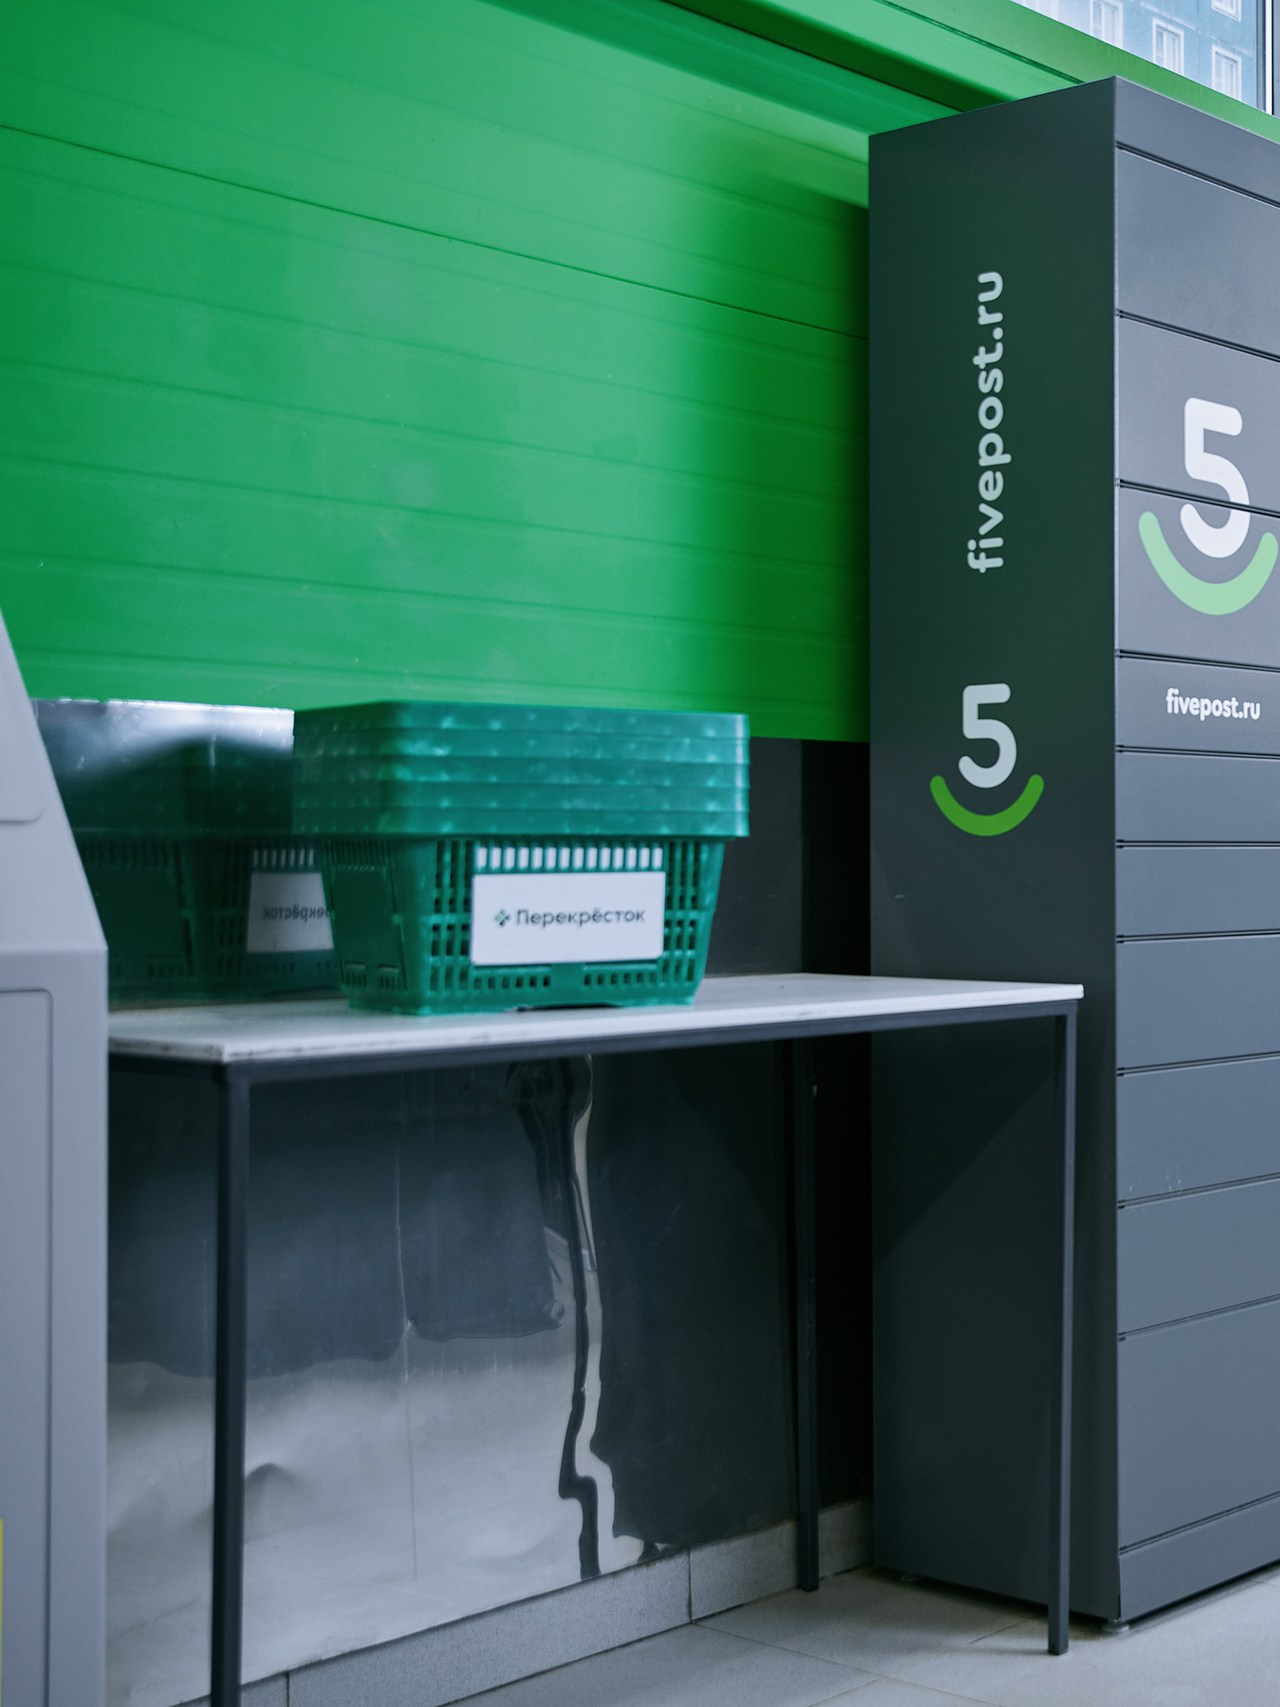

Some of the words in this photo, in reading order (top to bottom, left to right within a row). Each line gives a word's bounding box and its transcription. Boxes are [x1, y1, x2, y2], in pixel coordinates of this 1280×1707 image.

[967, 271, 1012, 573] fivepost.ru
[1180, 397, 1251, 558] 5
[958, 682, 1017, 789] 5
[1165, 688, 1261, 721] fivepost.ru
[516, 907, 645, 928] Перекрёсток
